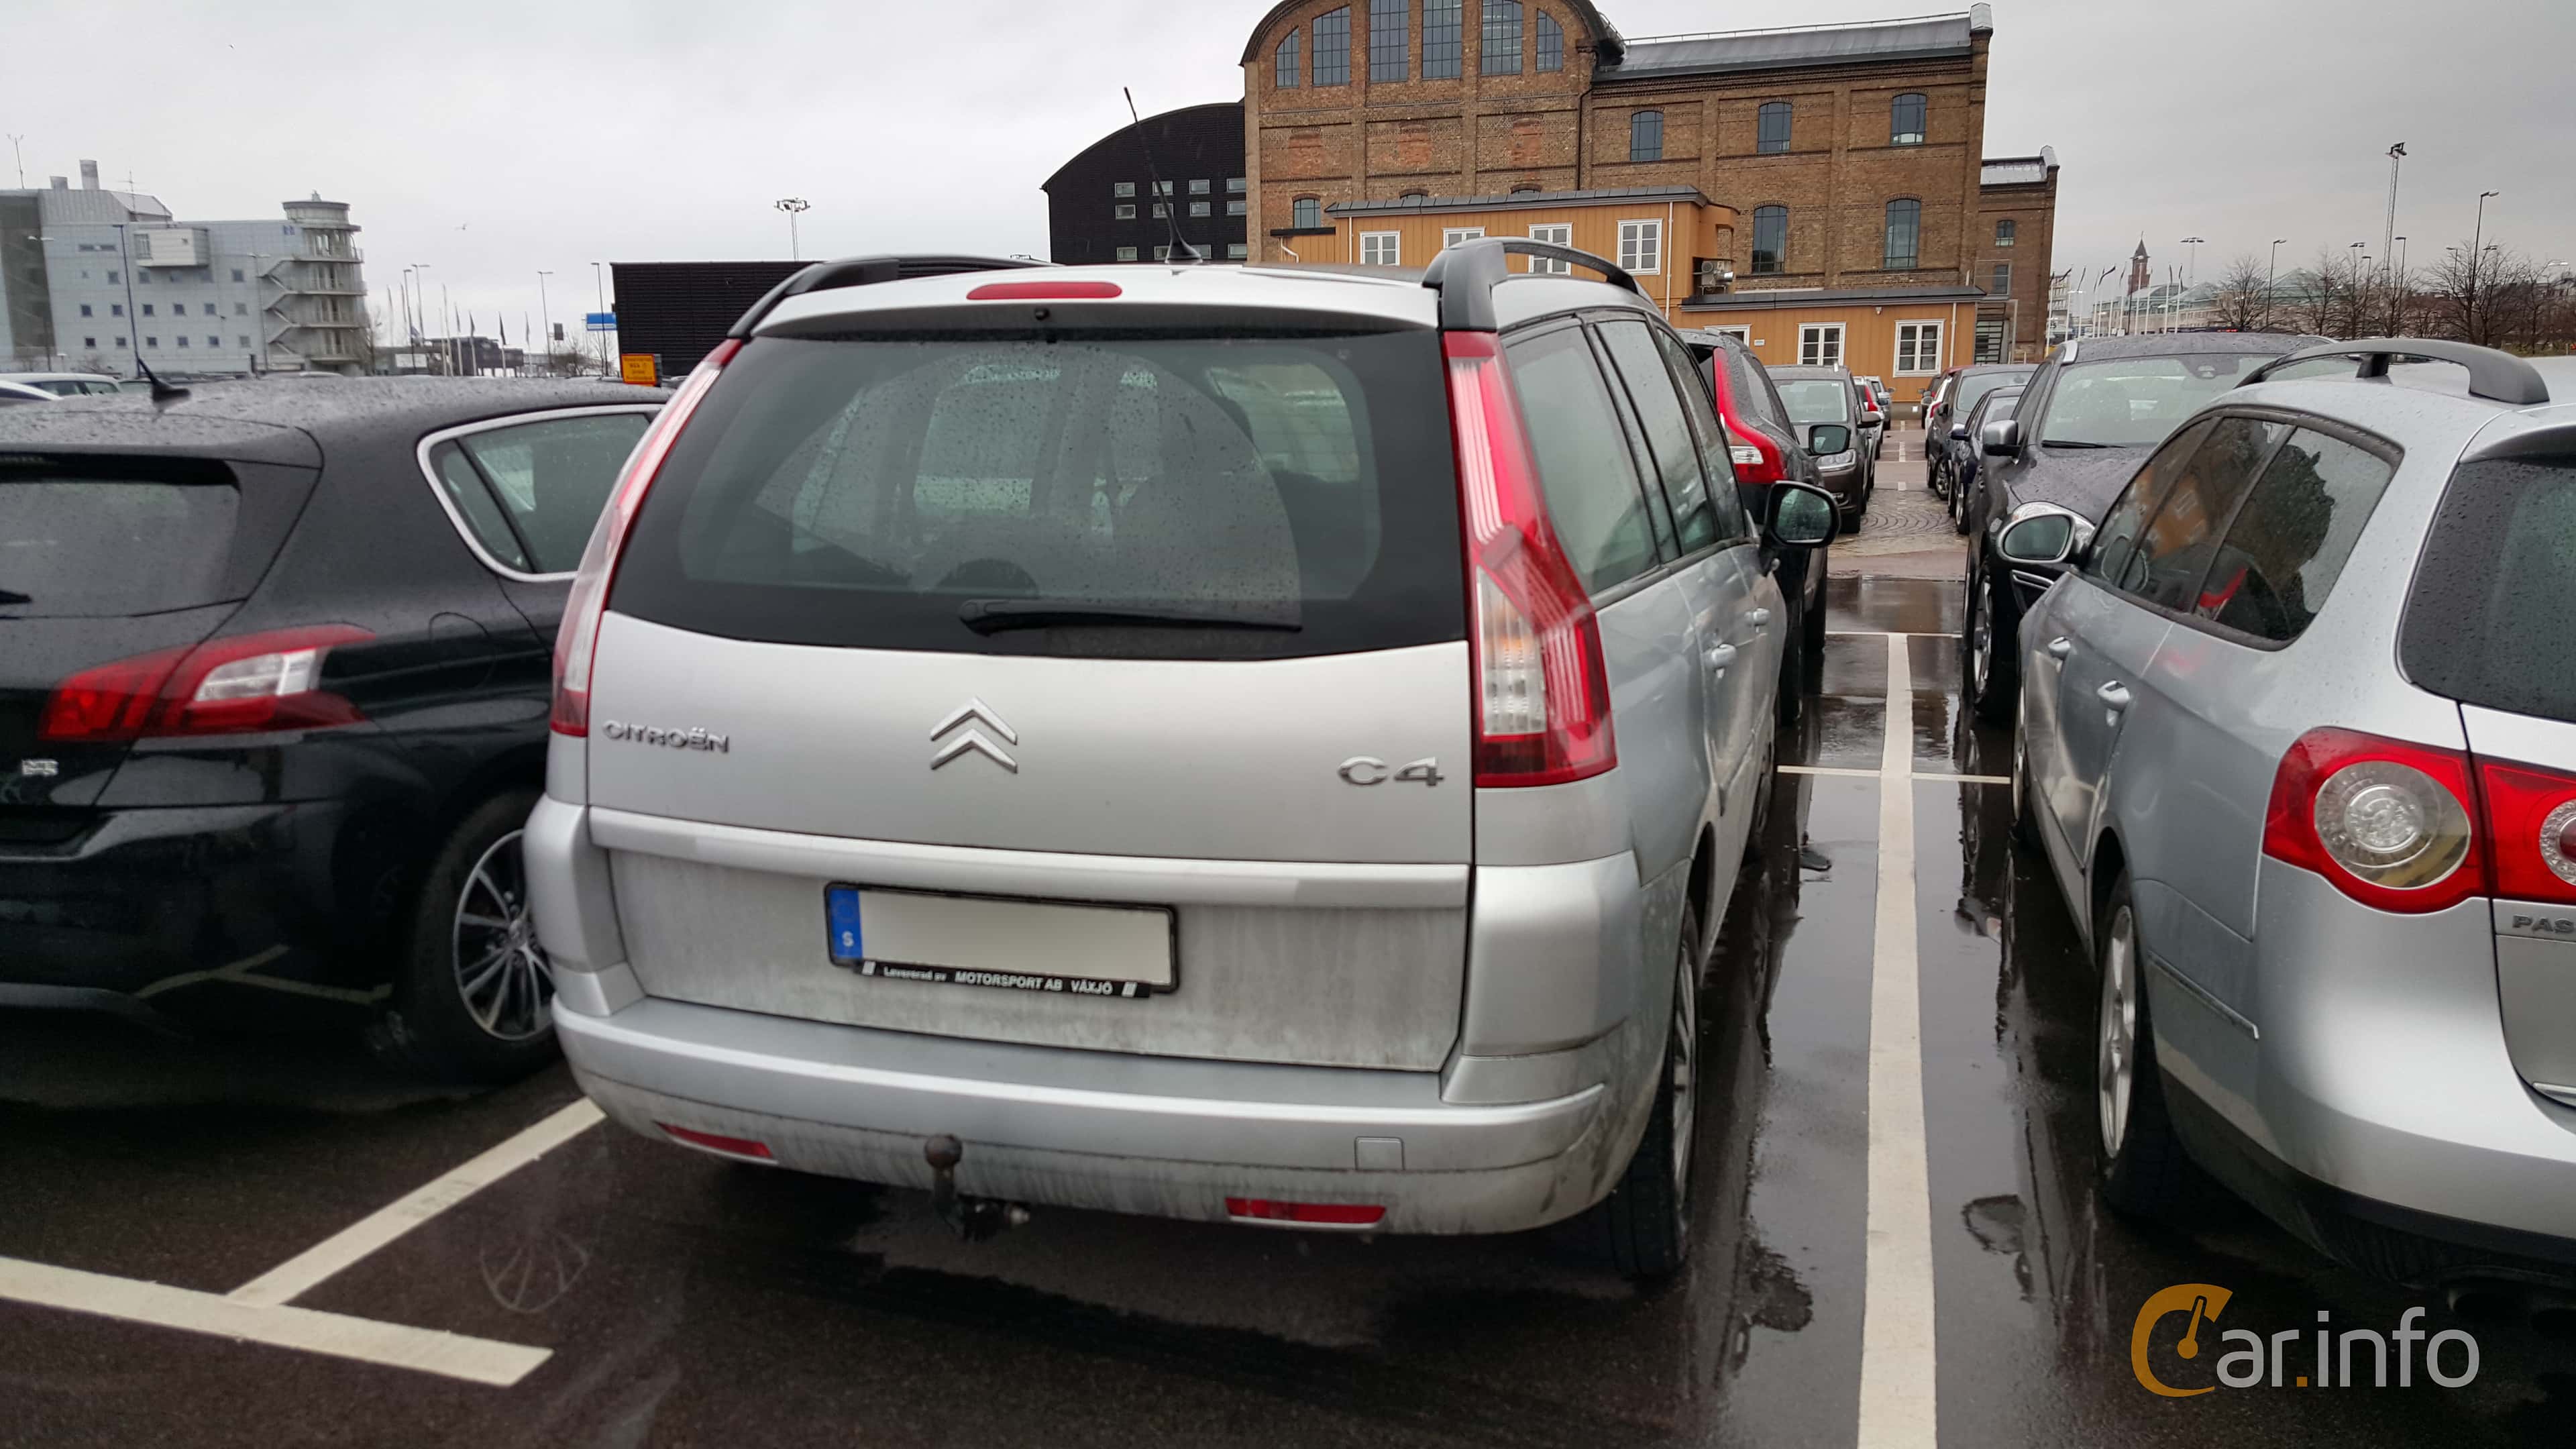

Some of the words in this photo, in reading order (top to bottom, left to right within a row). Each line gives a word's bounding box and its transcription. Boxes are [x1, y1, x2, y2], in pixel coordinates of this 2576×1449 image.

[602, 719, 730, 753] CITROËN
[1338, 756, 1445, 787] C4
[841, 931, 855, 947] S
[955, 971, 1044, 989] MOTORSPORT
[1044, 979, 1063, 991] AB
[1071, 979, 1114, 995] VÄXJÖ
